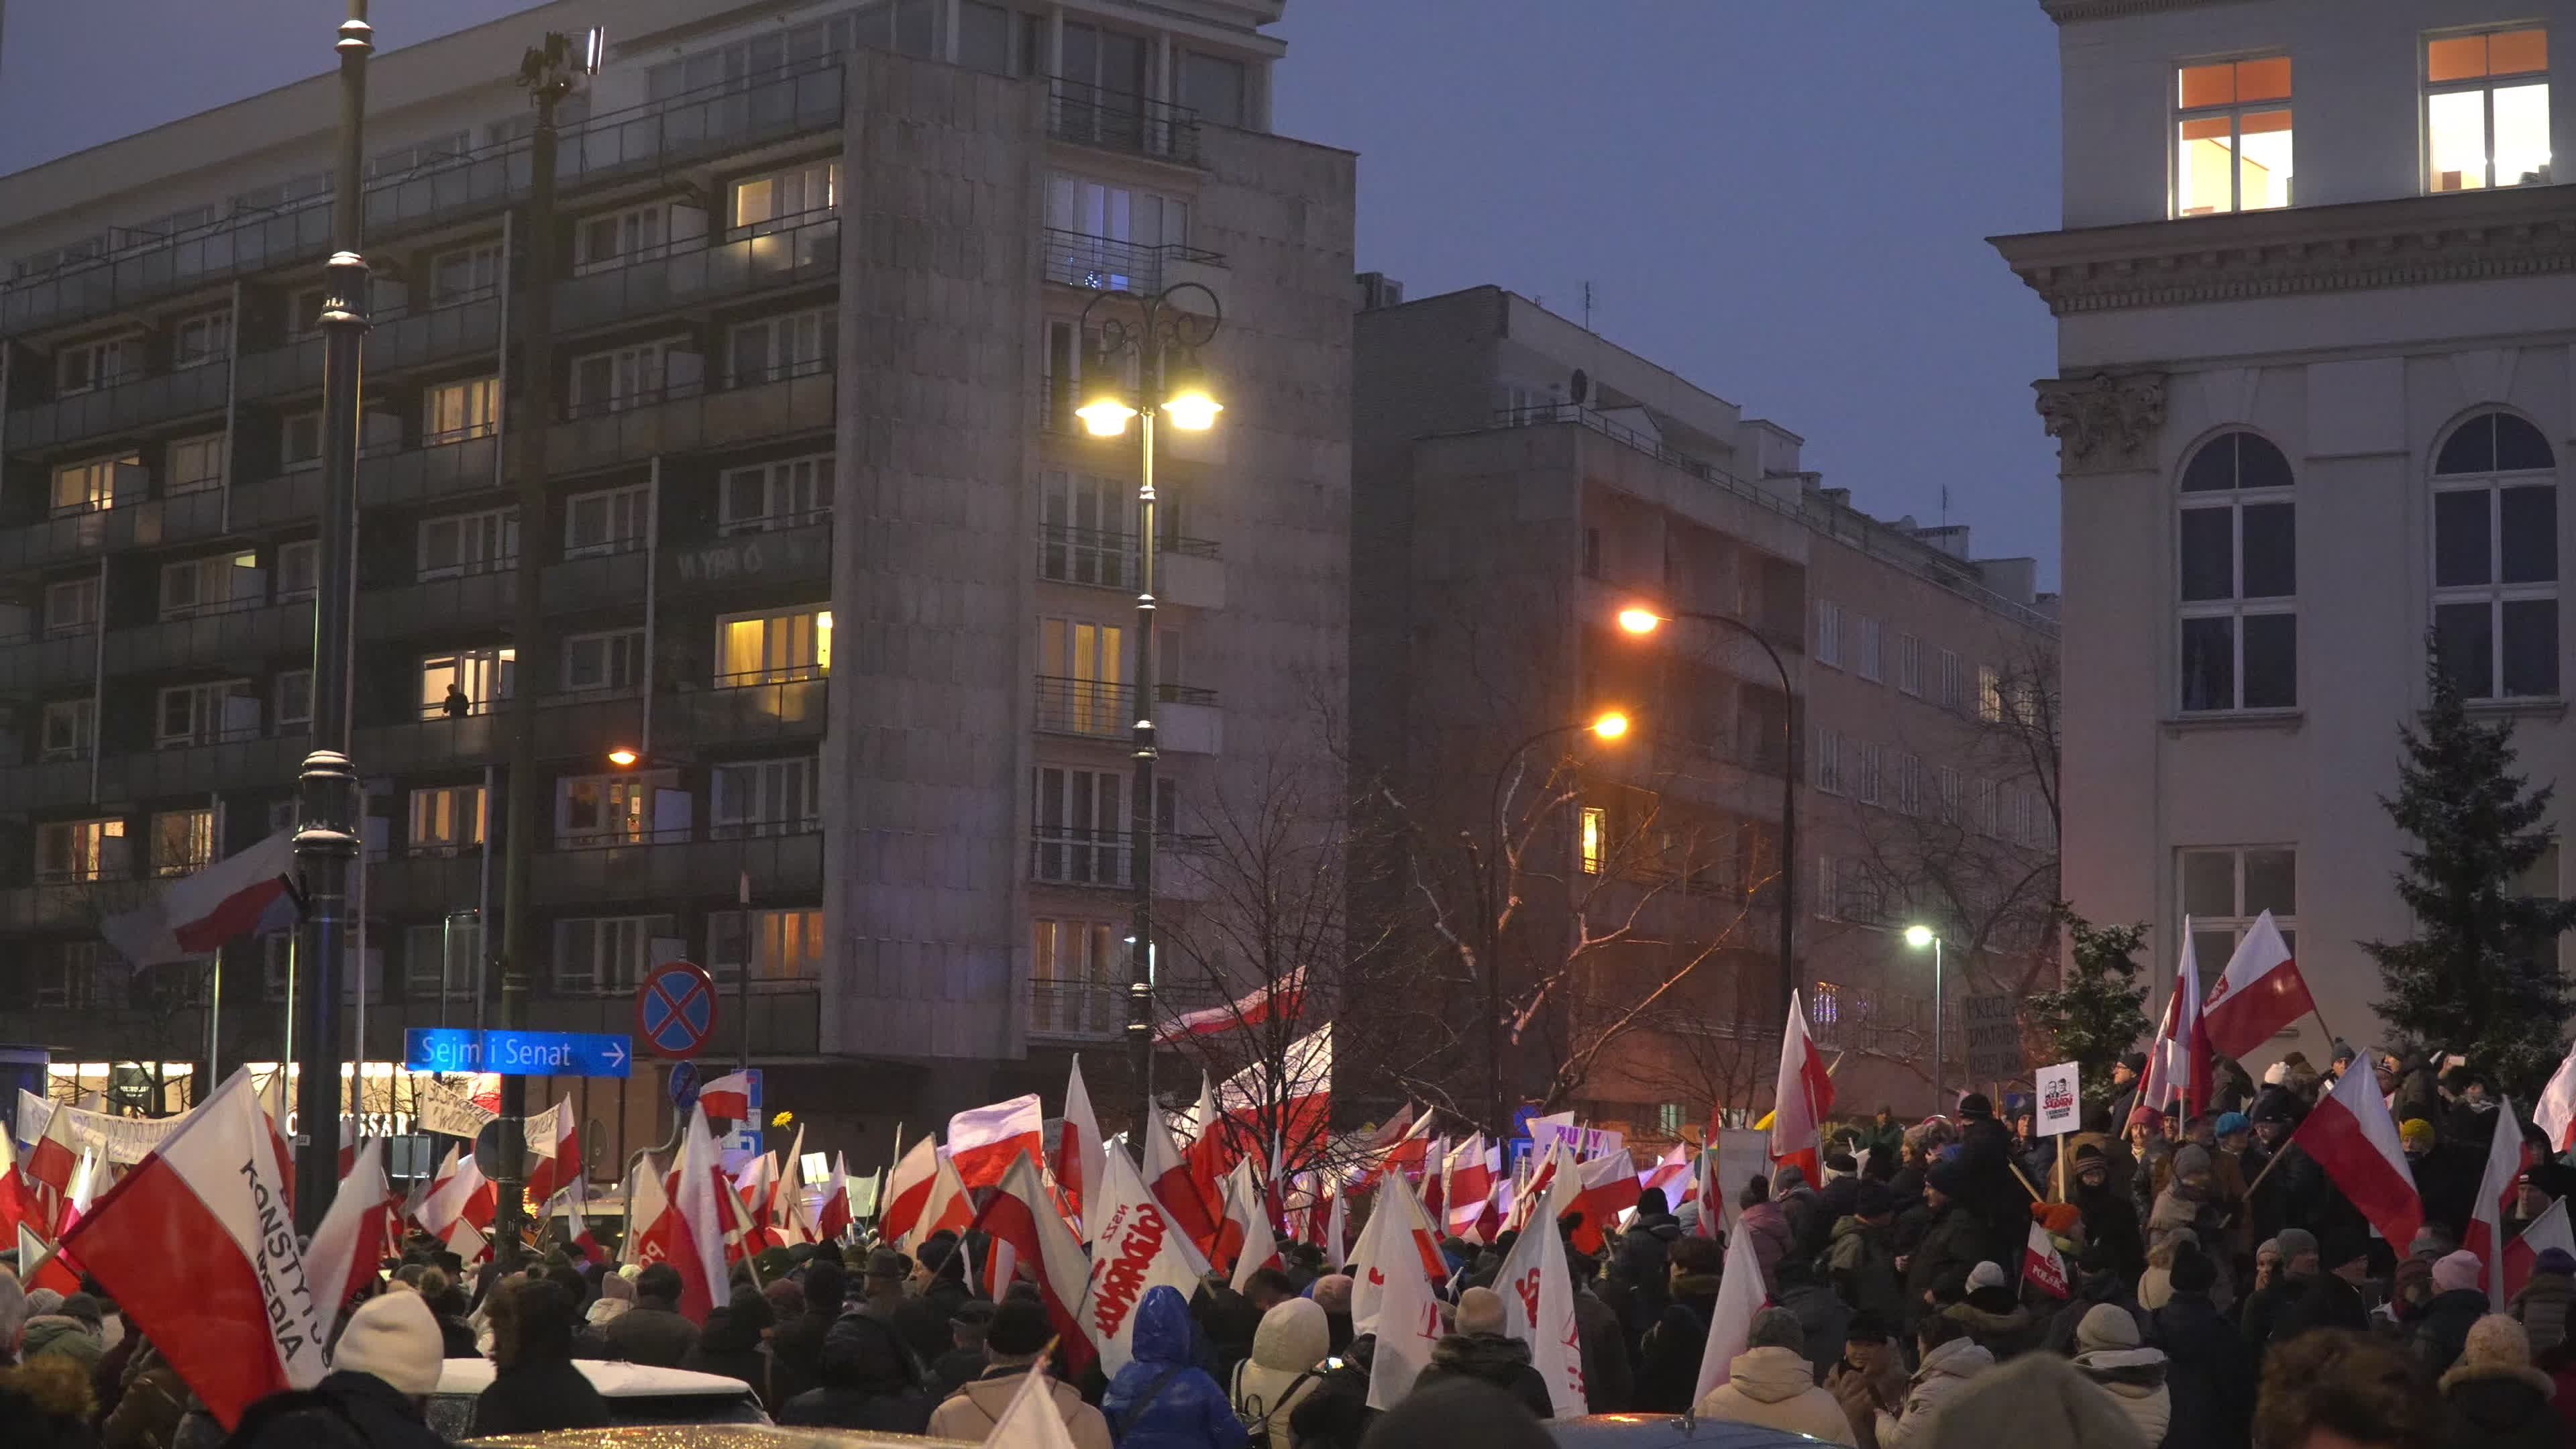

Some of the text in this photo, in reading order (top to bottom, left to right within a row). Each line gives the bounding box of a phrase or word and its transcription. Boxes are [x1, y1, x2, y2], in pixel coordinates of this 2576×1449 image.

[422, 1036, 570, 1070] Sejm i Senat
[256, 1249, 304, 1363] MEDIA
